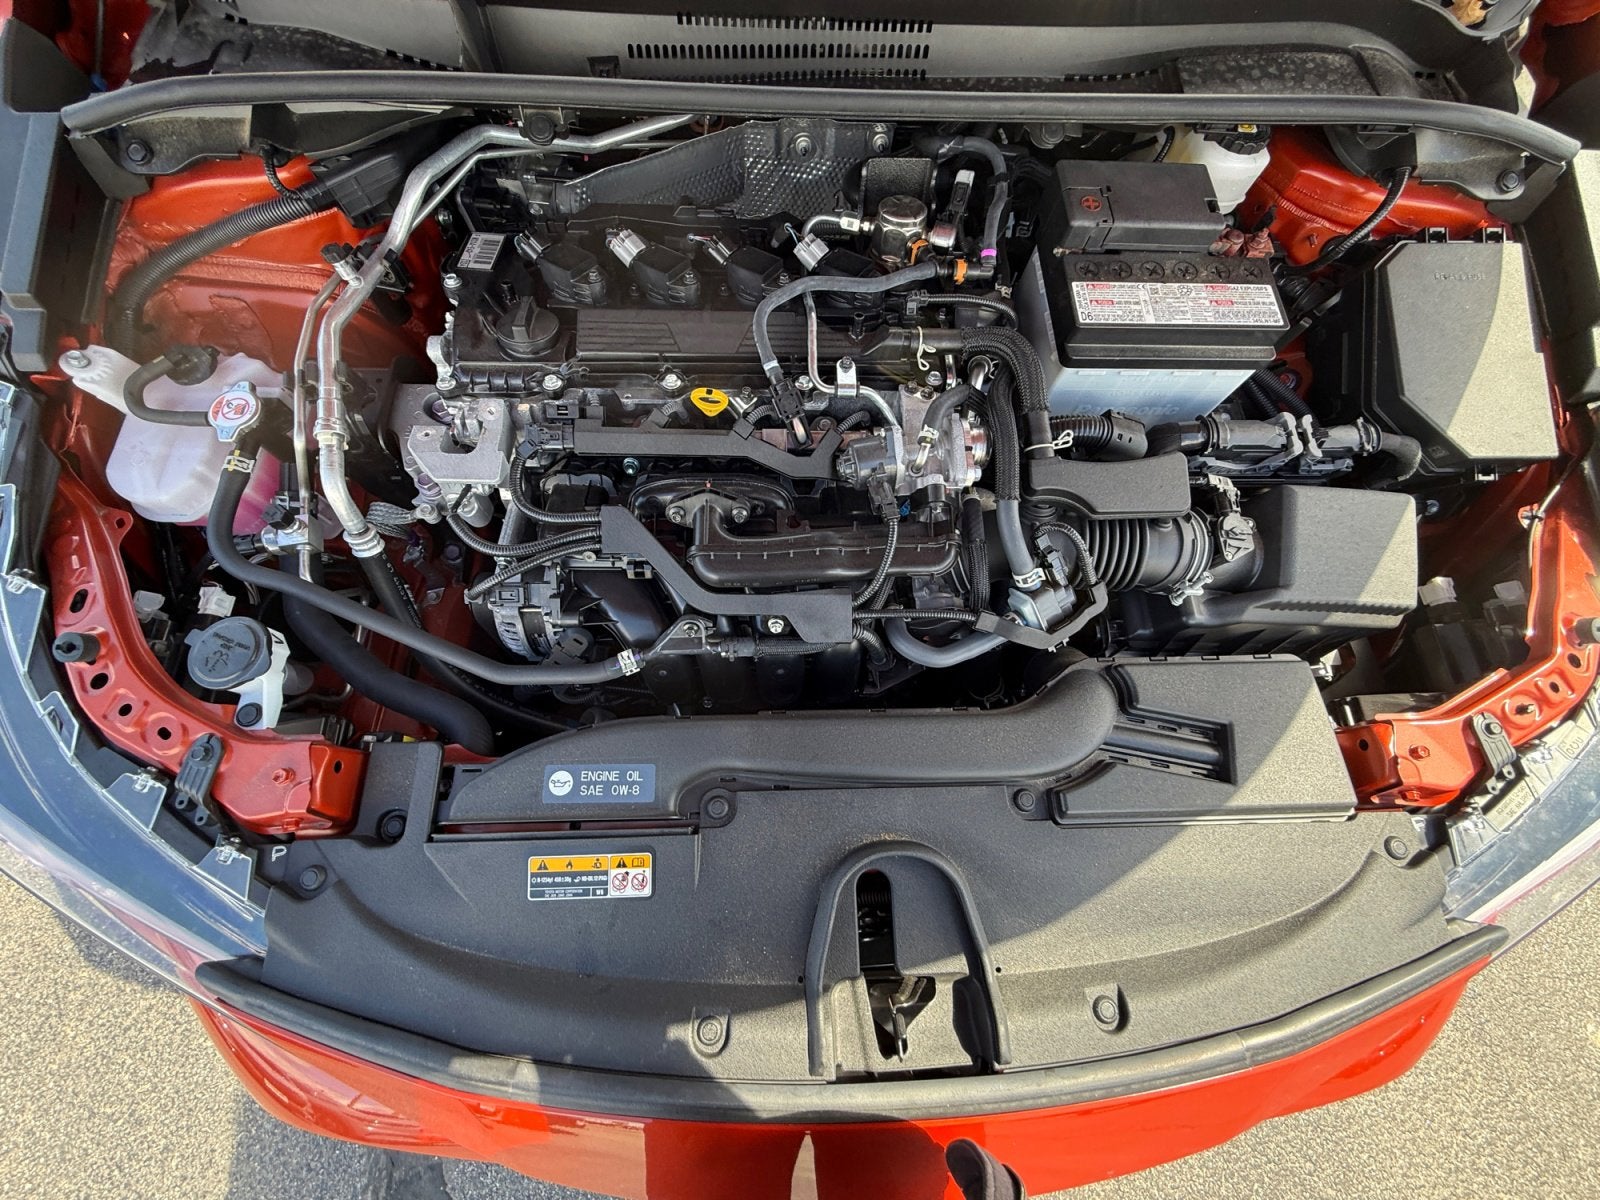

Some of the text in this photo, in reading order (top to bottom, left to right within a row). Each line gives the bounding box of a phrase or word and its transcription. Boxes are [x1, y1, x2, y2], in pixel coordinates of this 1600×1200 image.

[1080, 311, 1094, 321] D6
[580, 770, 644, 782] ENGINE OIL
[579, 784, 641, 796] SAE 0W-8
[271, 845, 287, 862] P
